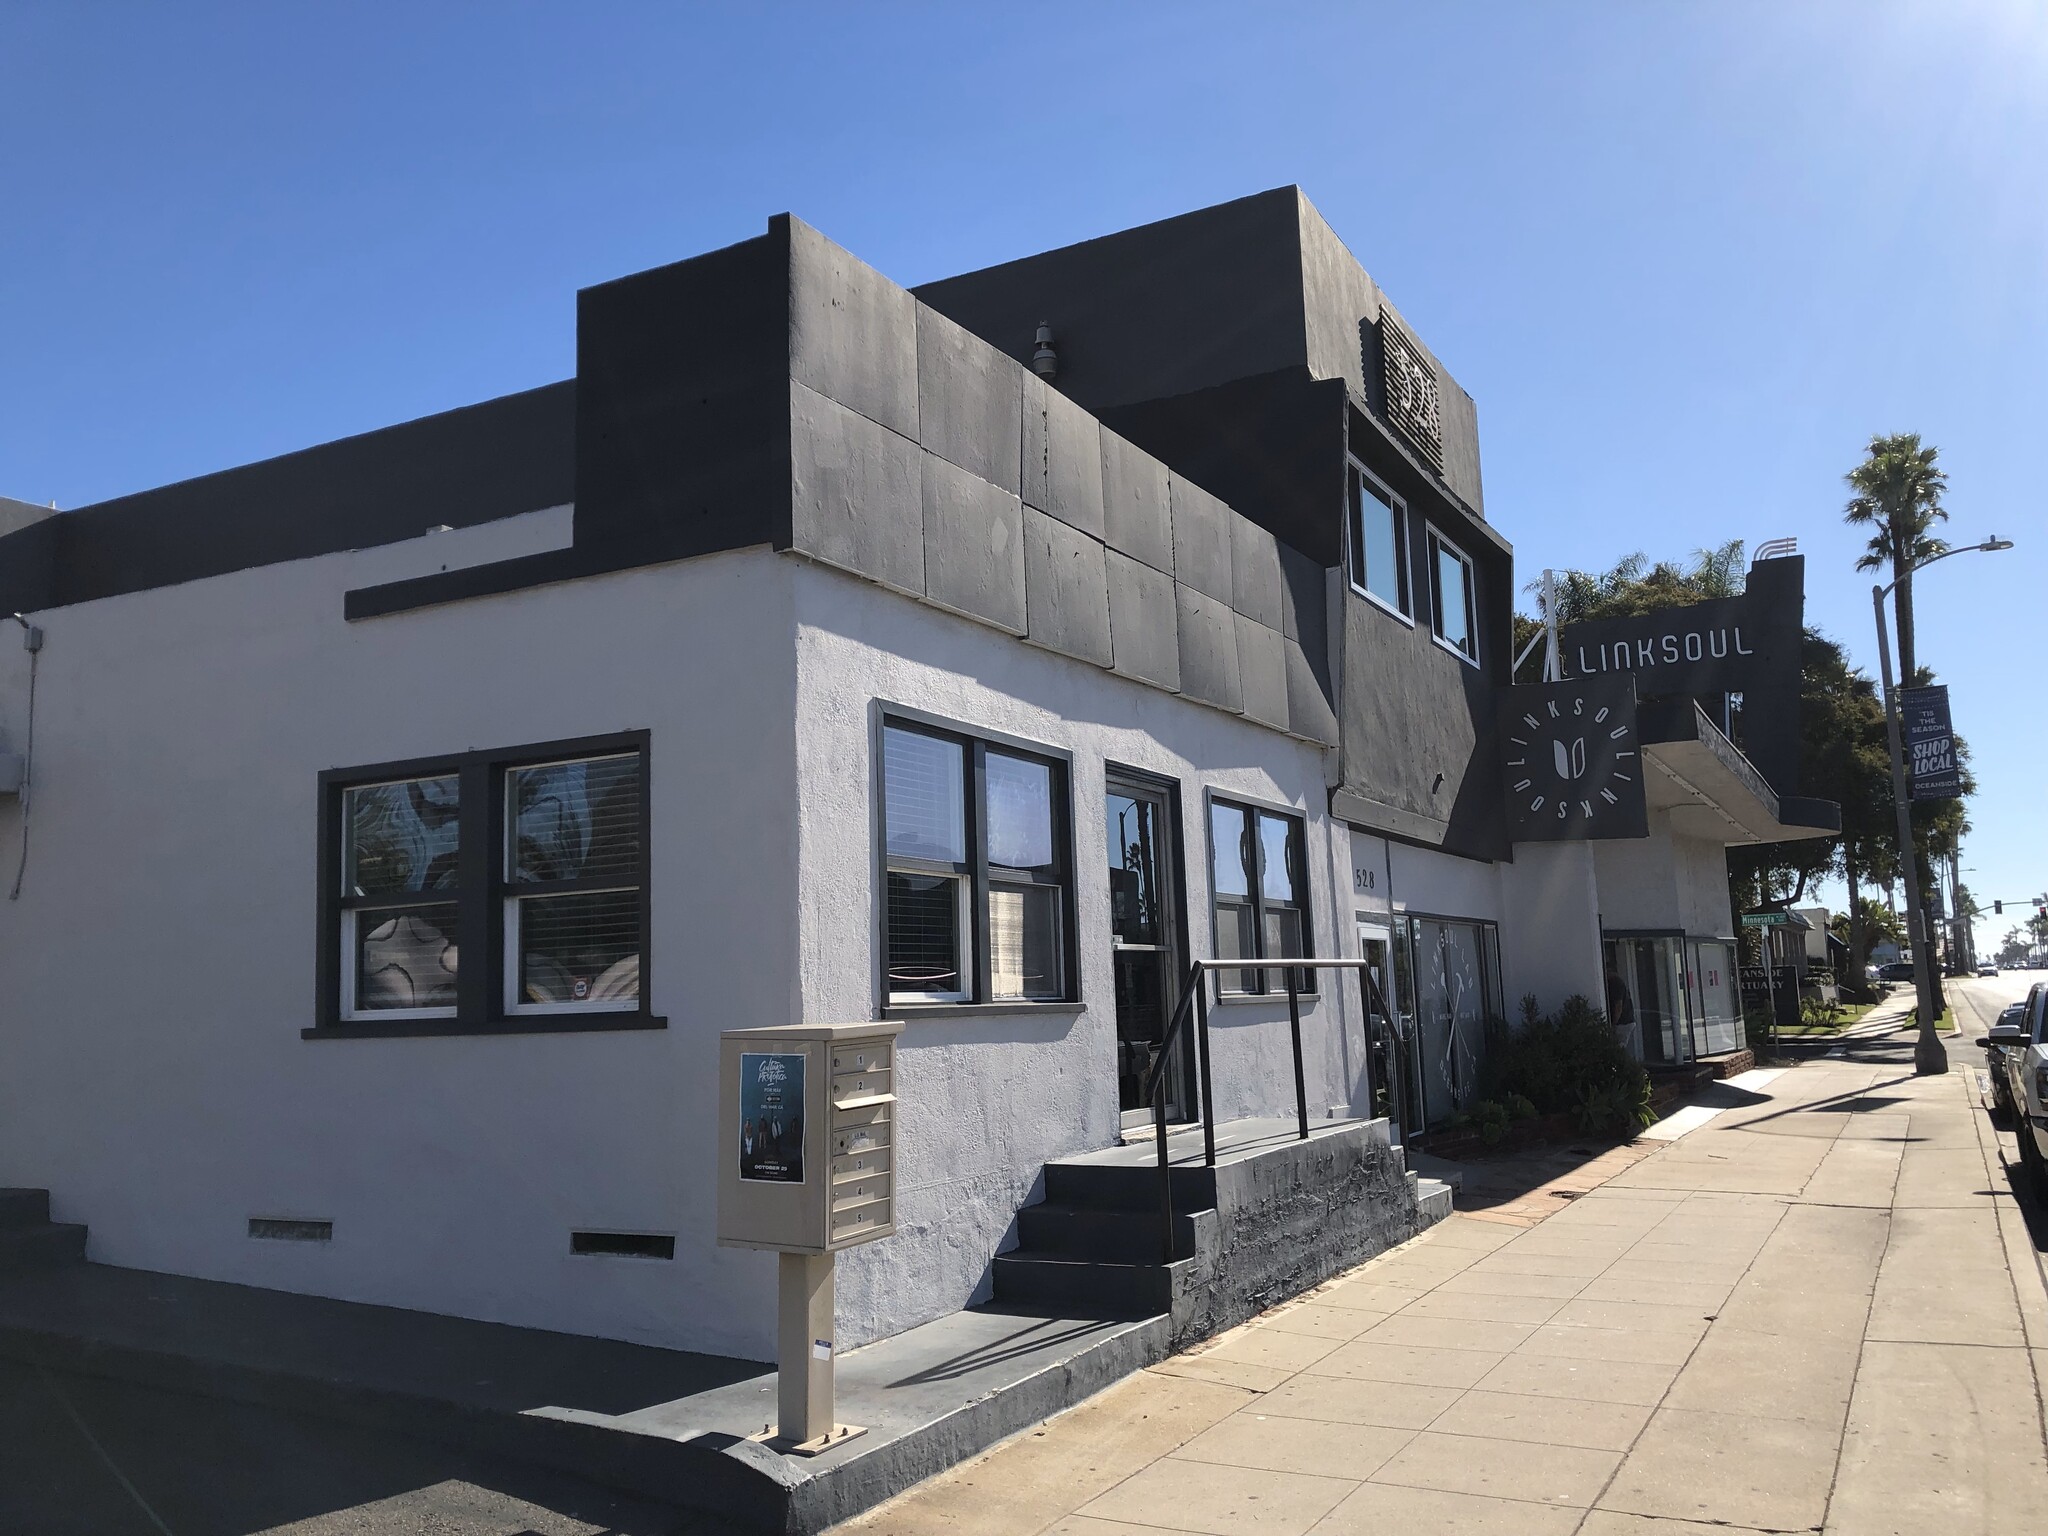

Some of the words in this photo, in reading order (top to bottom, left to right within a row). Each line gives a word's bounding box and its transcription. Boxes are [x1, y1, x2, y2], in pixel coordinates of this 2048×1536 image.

[1579, 627, 1754, 674] LINKSOUL
[1911, 724, 1946, 733] SEASON
[1913, 739, 1950, 760] SHOP
[1914, 753, 1953, 775] LOCAL
[1915, 780, 1957, 790] OCEANSIDE
[1356, 868, 1375, 889] 528
[1742, 915, 1775, 925] Minnesota
[1741, 981, 1784, 990] RTUARY
